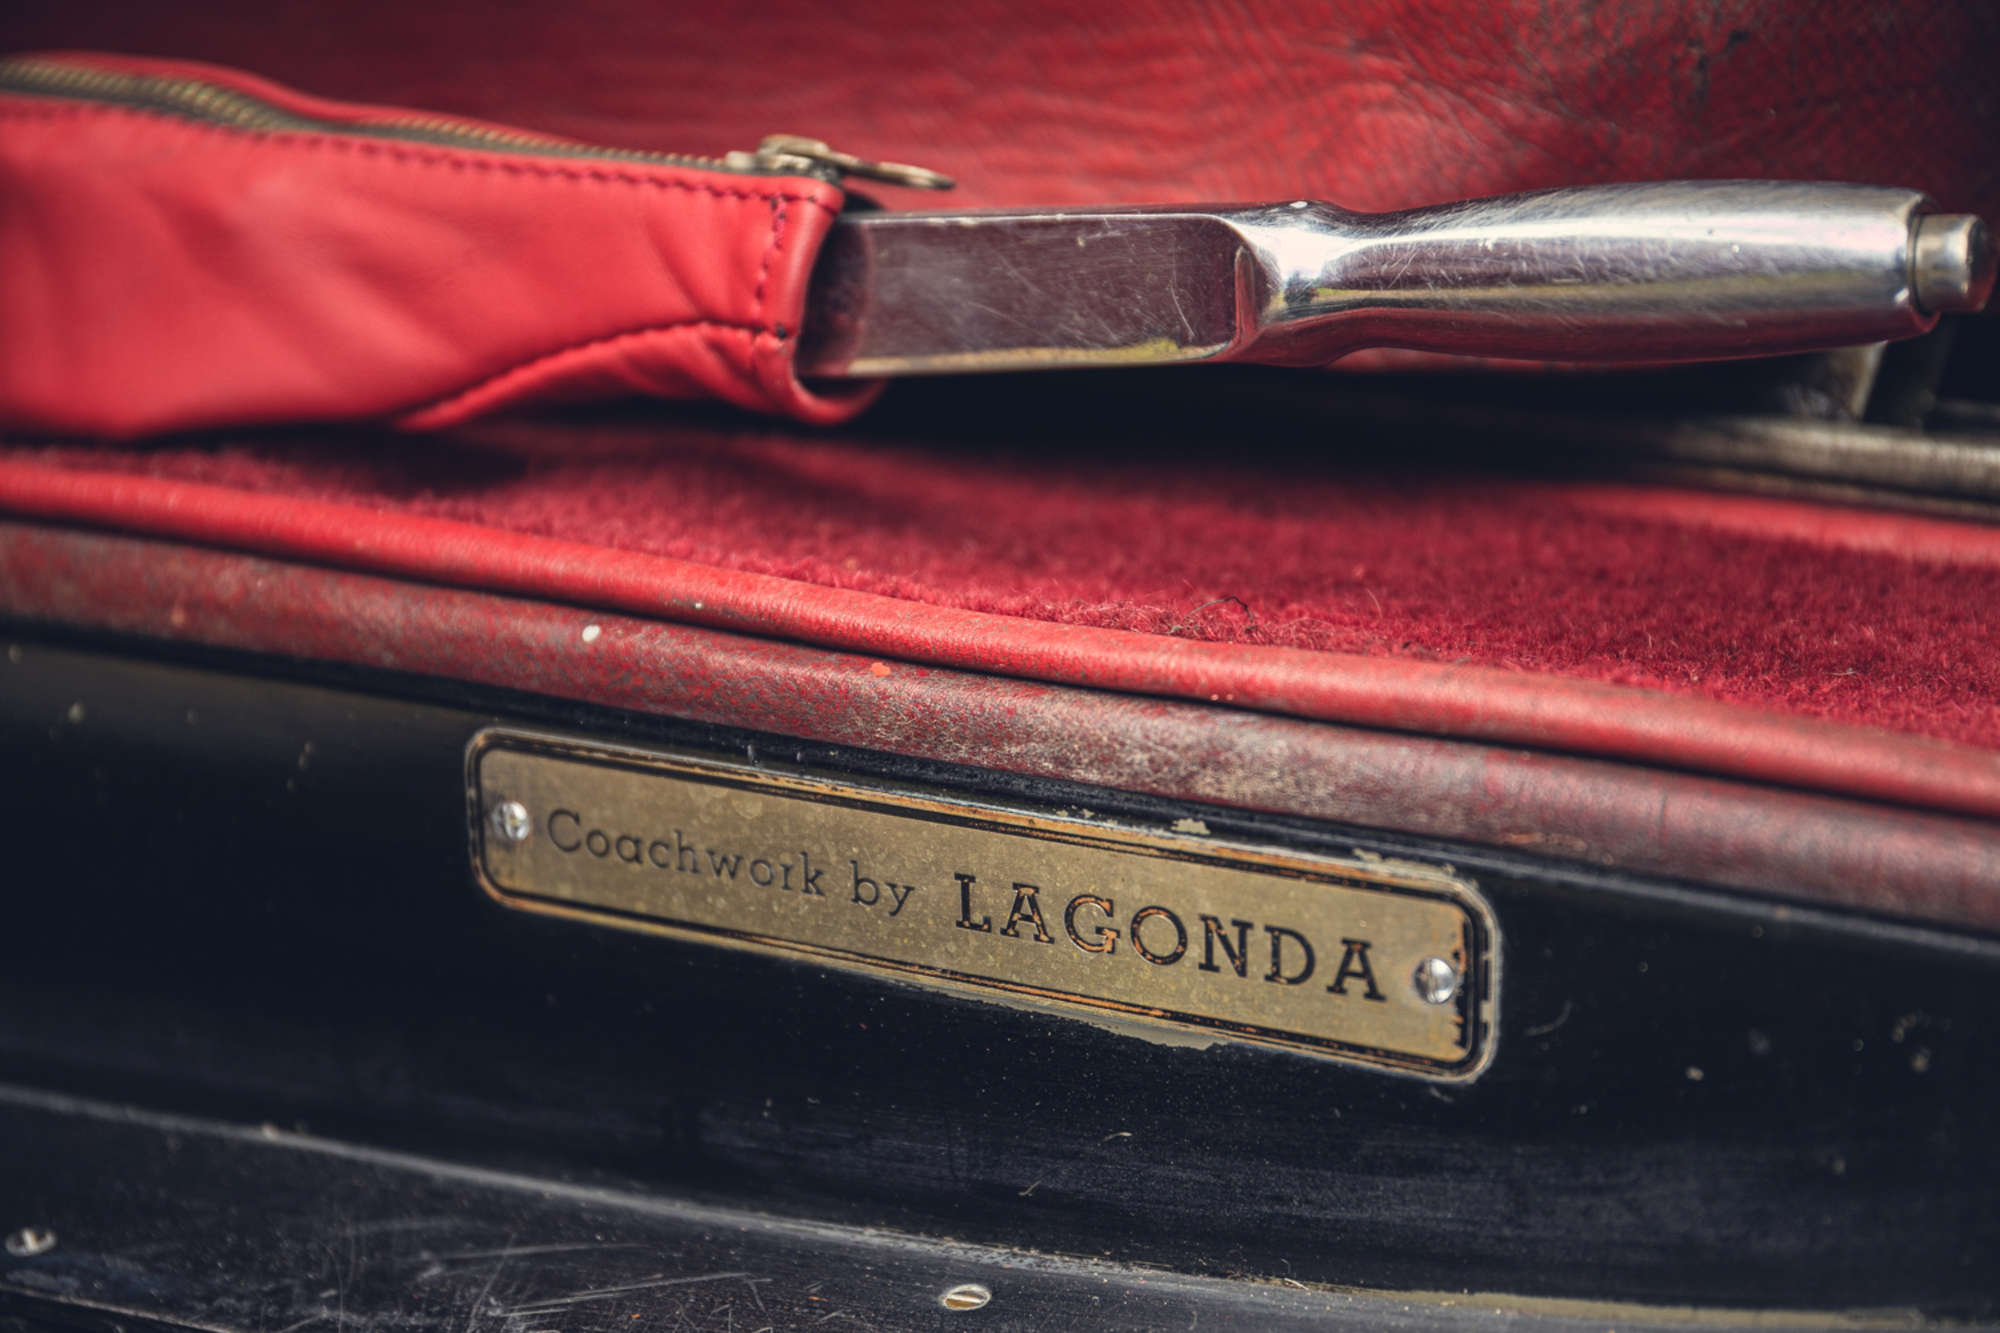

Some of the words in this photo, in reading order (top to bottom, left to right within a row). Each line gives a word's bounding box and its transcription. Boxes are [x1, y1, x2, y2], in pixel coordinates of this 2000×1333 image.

[546, 807, 827, 898] Coachwork
[849, 859, 916, 918] by
[953, 871, 1388, 1002] LAGONDA
